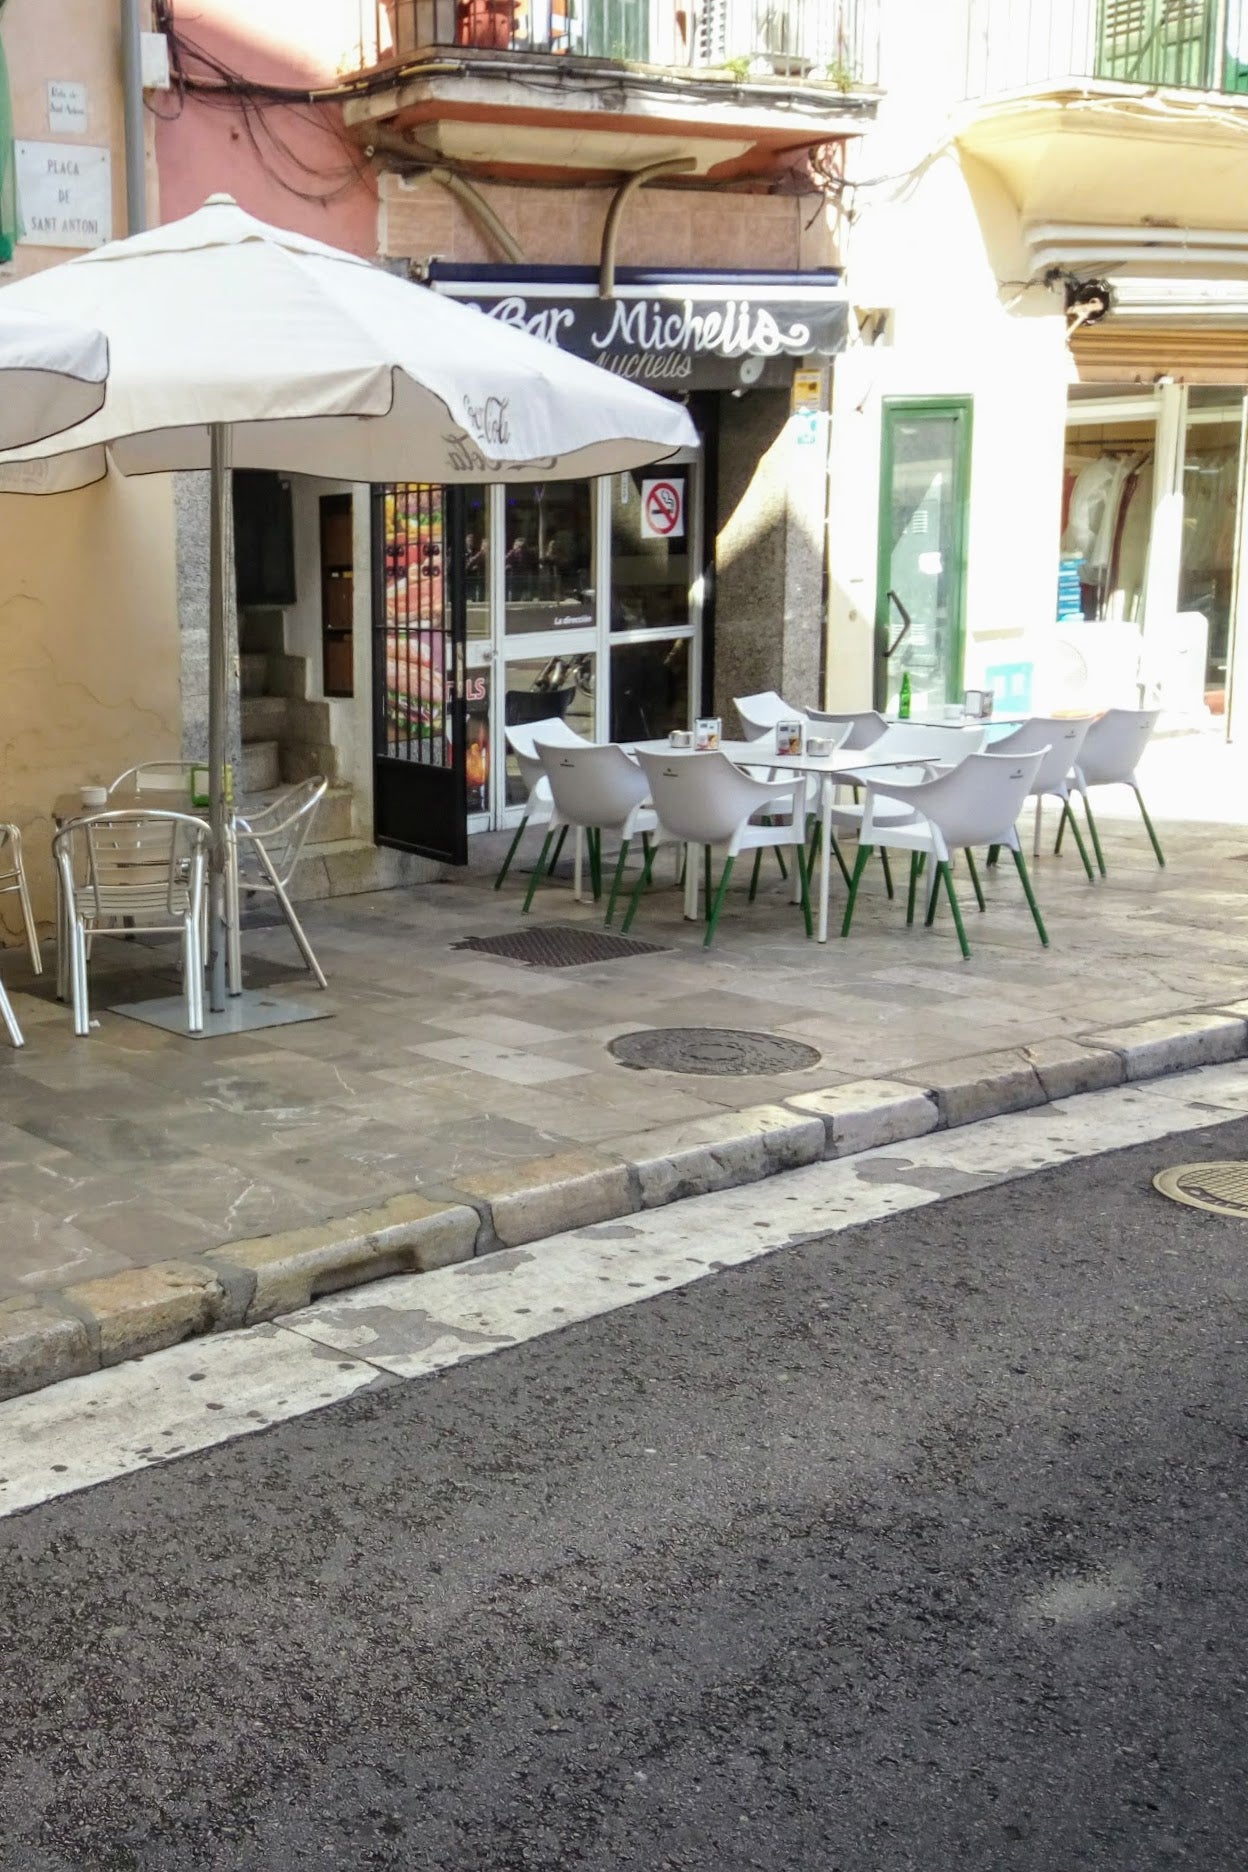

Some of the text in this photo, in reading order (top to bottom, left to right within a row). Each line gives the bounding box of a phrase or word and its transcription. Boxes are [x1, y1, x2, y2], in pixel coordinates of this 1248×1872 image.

[58, 189, 70, 204] DE
[31, 216, 98, 234] SANT ANTONI
[592, 299, 810, 353] Michelis
